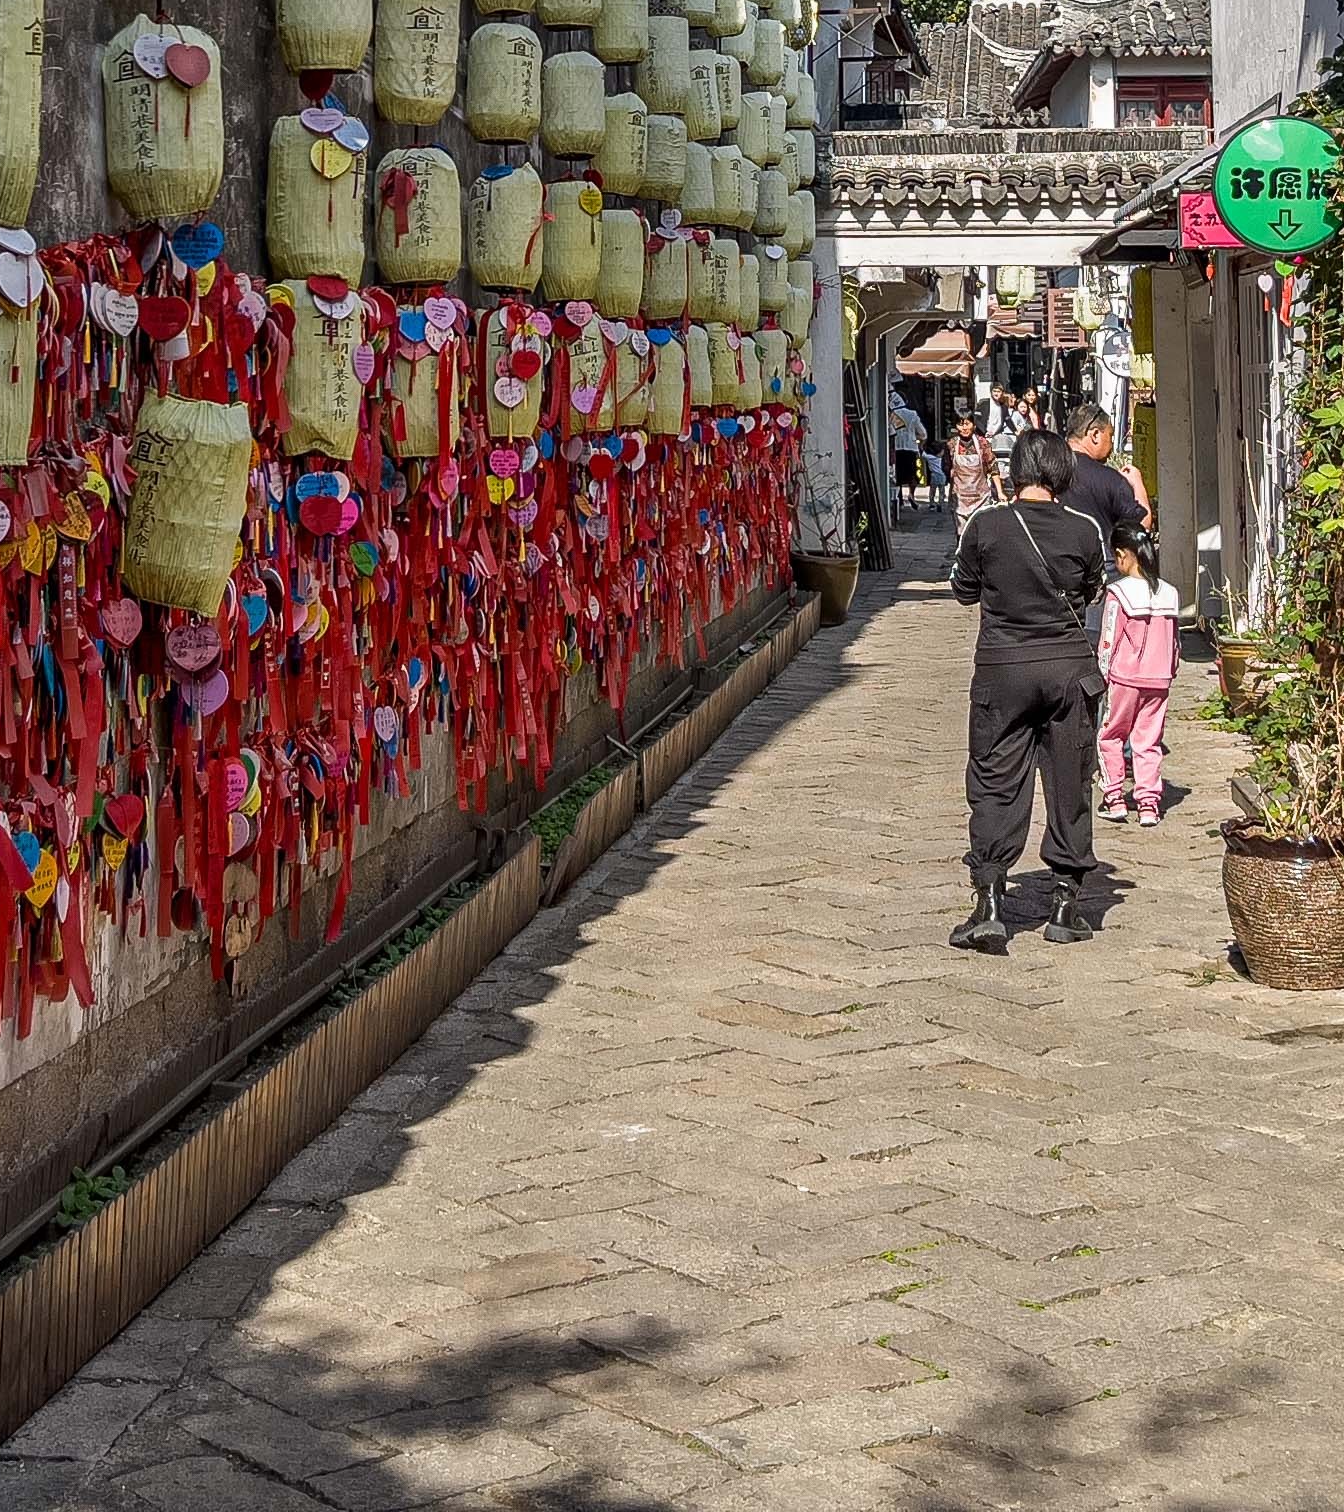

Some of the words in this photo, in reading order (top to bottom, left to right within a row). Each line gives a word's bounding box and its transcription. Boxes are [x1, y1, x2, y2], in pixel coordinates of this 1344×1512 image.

[129, 83, 158, 176] 明清巷美食街
[329, 343, 350, 422] 明清巷美食街
[129, 470, 160, 566] 明清巷美食街
